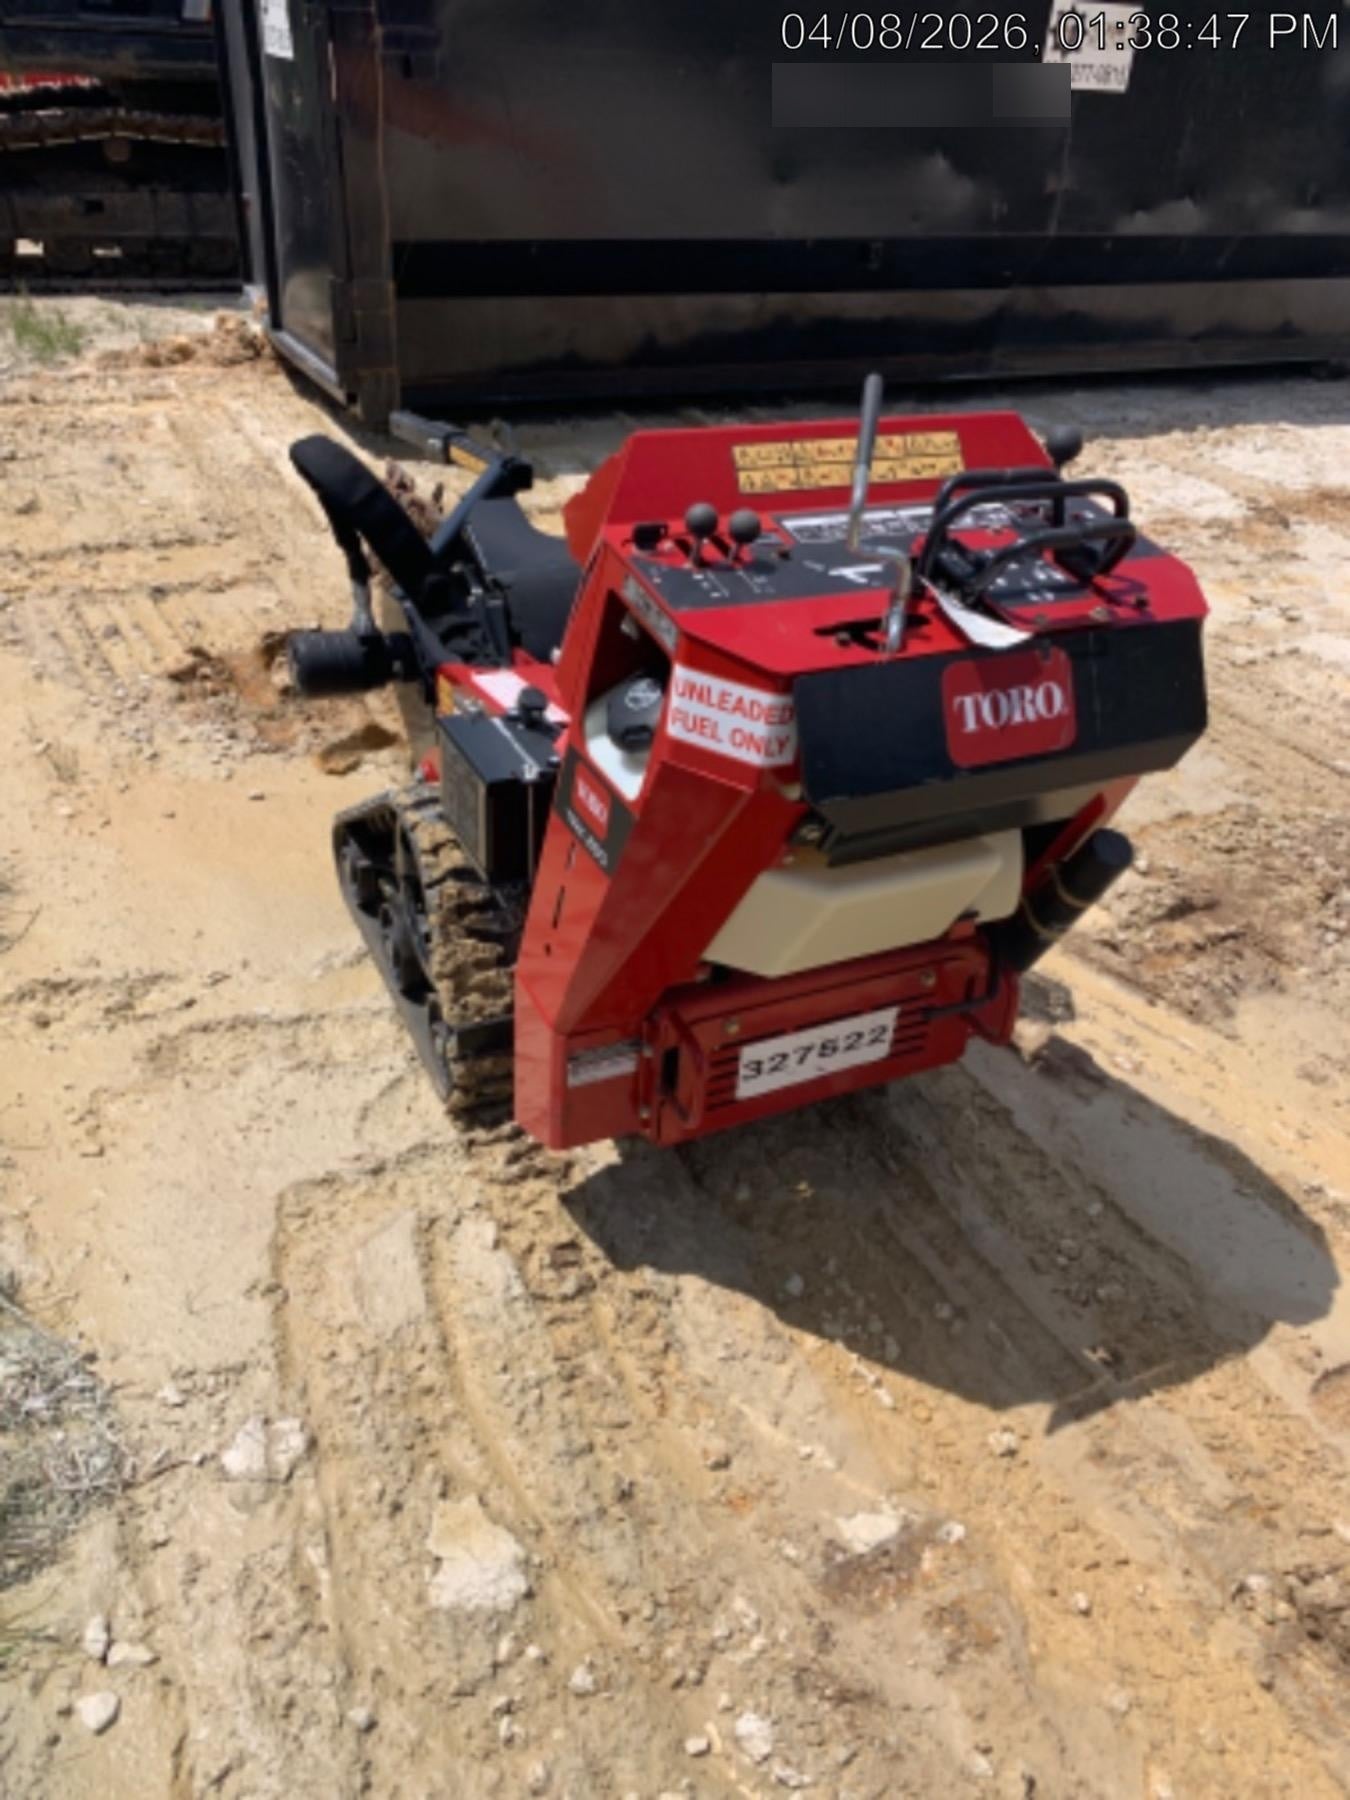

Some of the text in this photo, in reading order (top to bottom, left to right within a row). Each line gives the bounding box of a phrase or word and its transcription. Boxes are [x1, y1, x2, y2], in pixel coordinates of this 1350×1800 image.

[674, 679, 794, 726] UNLEADED
[953, 681, 1064, 733] TORO
[671, 708, 790, 758] FUEL ONLY
